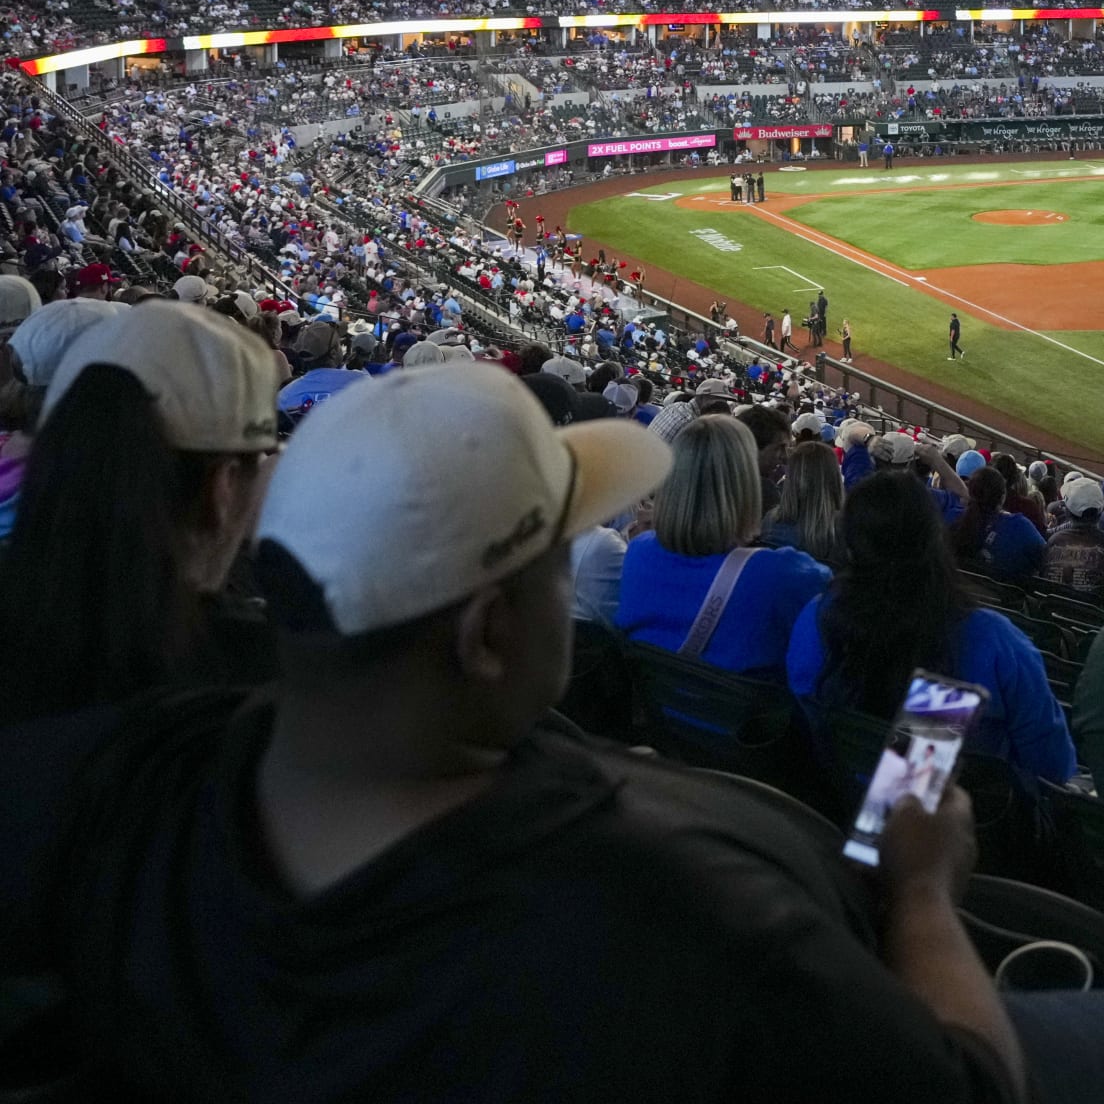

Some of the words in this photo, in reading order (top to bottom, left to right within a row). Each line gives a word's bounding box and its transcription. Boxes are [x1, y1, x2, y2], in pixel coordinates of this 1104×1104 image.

[758, 128, 809, 139] Budweiser
[993, 124, 1019, 140] Kroger
[1036, 123, 1062, 137] Kroger
[592, 146, 603, 154] 2X
[605, 144, 628, 153] FUEL
[630, 141, 662, 151] POINTS
